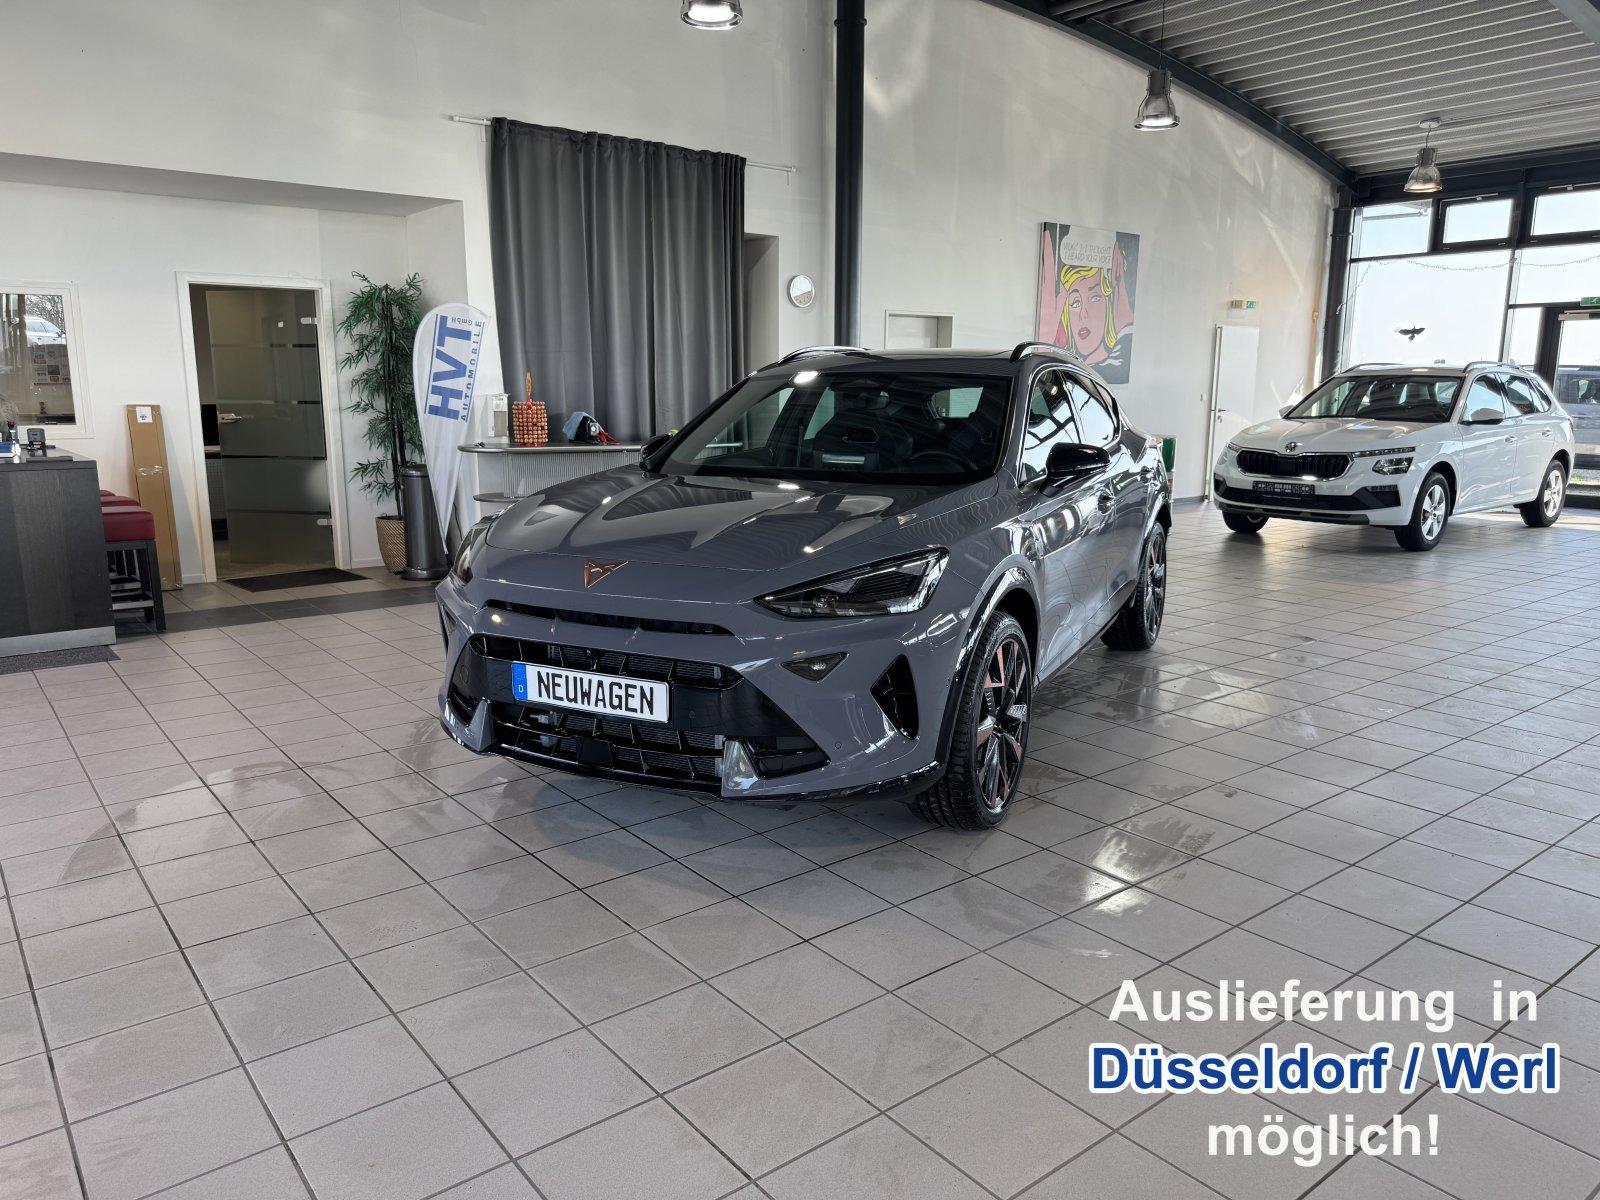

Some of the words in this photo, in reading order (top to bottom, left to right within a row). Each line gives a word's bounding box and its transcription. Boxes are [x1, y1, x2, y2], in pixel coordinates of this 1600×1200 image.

[451, 316, 473, 326] GmbH
[428, 314, 472, 420] HVT
[460, 321, 482, 421] AUTOMOBILE
[518, 685, 524, 693] D
[537, 670, 654, 715] NEUWAGEN
